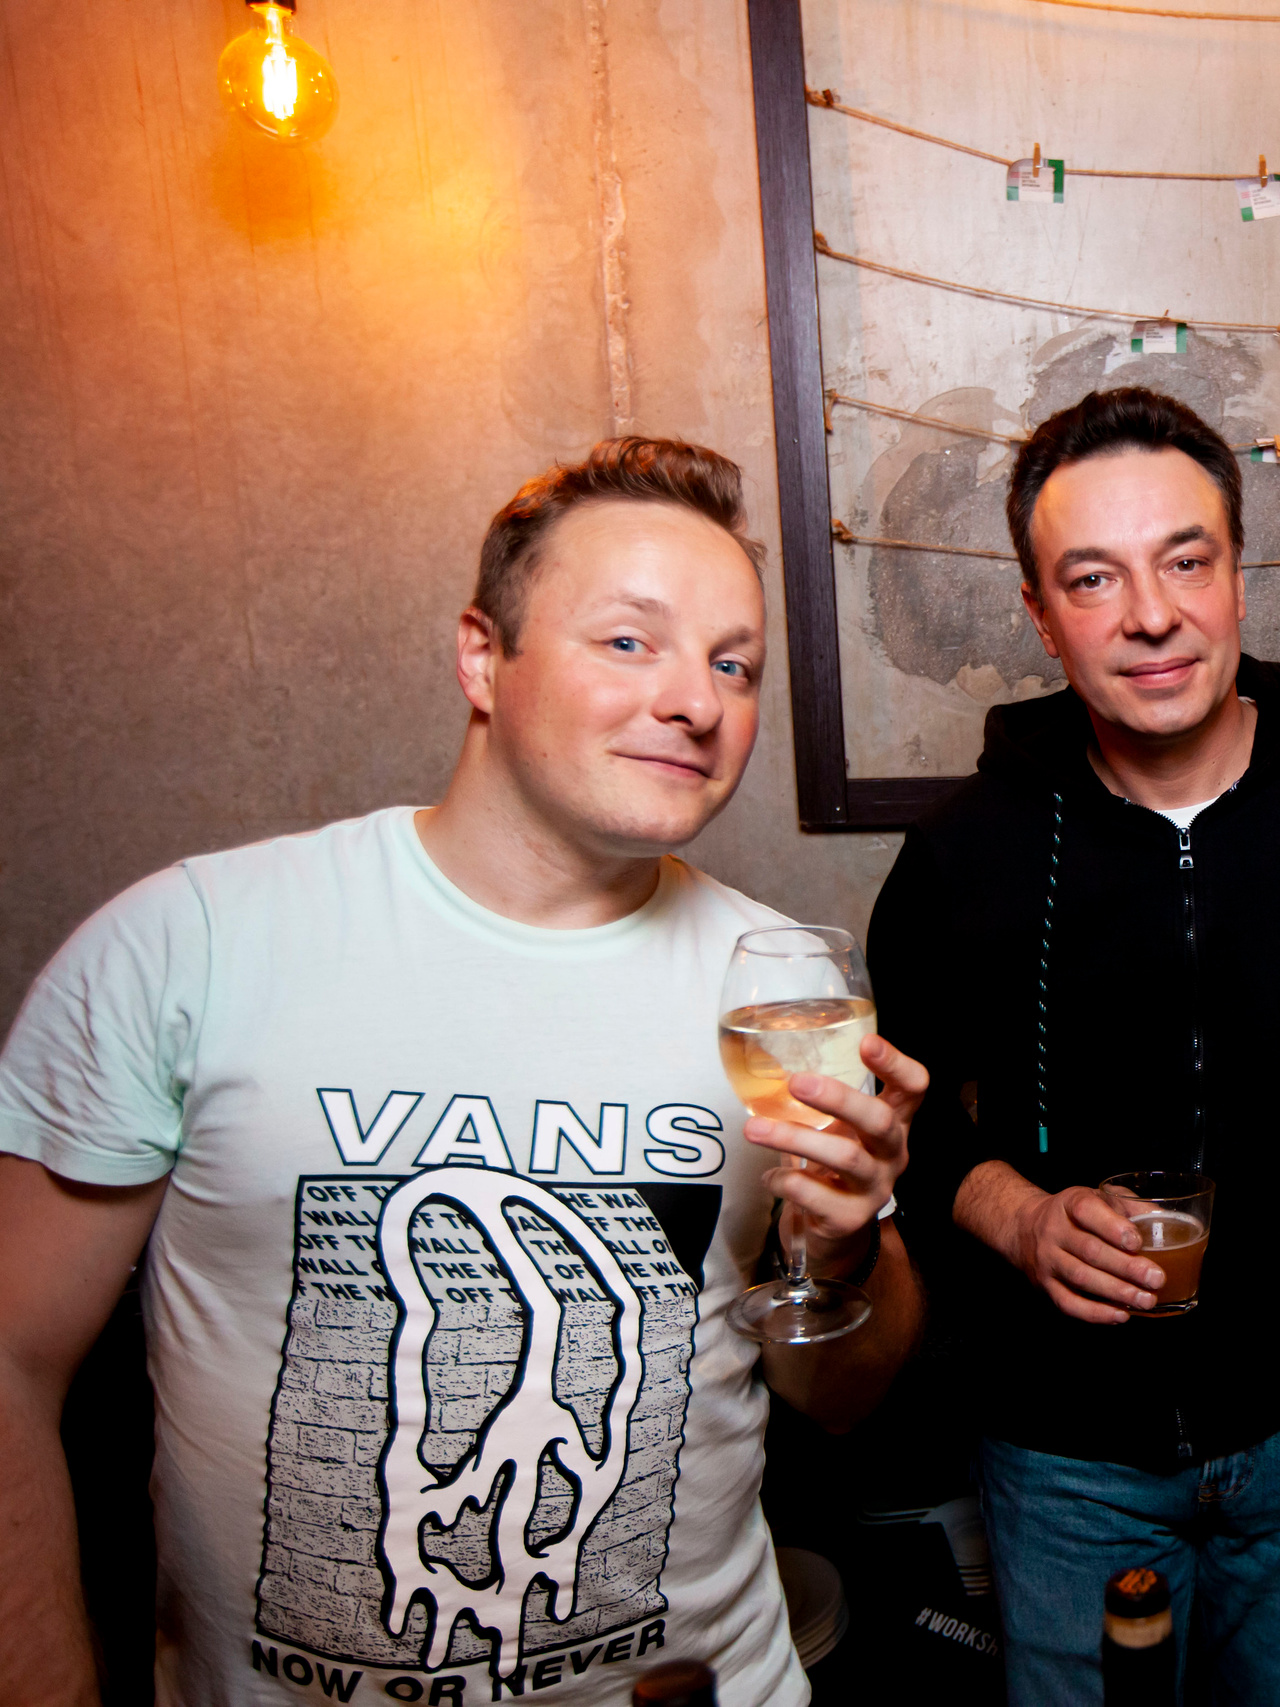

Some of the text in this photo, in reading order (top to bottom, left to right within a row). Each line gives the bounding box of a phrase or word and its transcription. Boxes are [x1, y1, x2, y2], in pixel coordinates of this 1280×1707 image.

[315, 1087, 727, 1178] VANS
[307, 1185, 358, 1203] OFF
[555, 1192, 600, 1209] HE
[583, 1216, 611, 1232] FF
[613, 1216, 662, 1232] THE
[604, 1239, 651, 1255] ALL
[422, 1262, 483, 1279] THE
[311, 1281, 368, 1301] THE
[446, 1287, 494, 1304] OFF
[636, 1284, 661, 1301] FF
[251, 1618, 667, 1707] NOW OR NEVER
